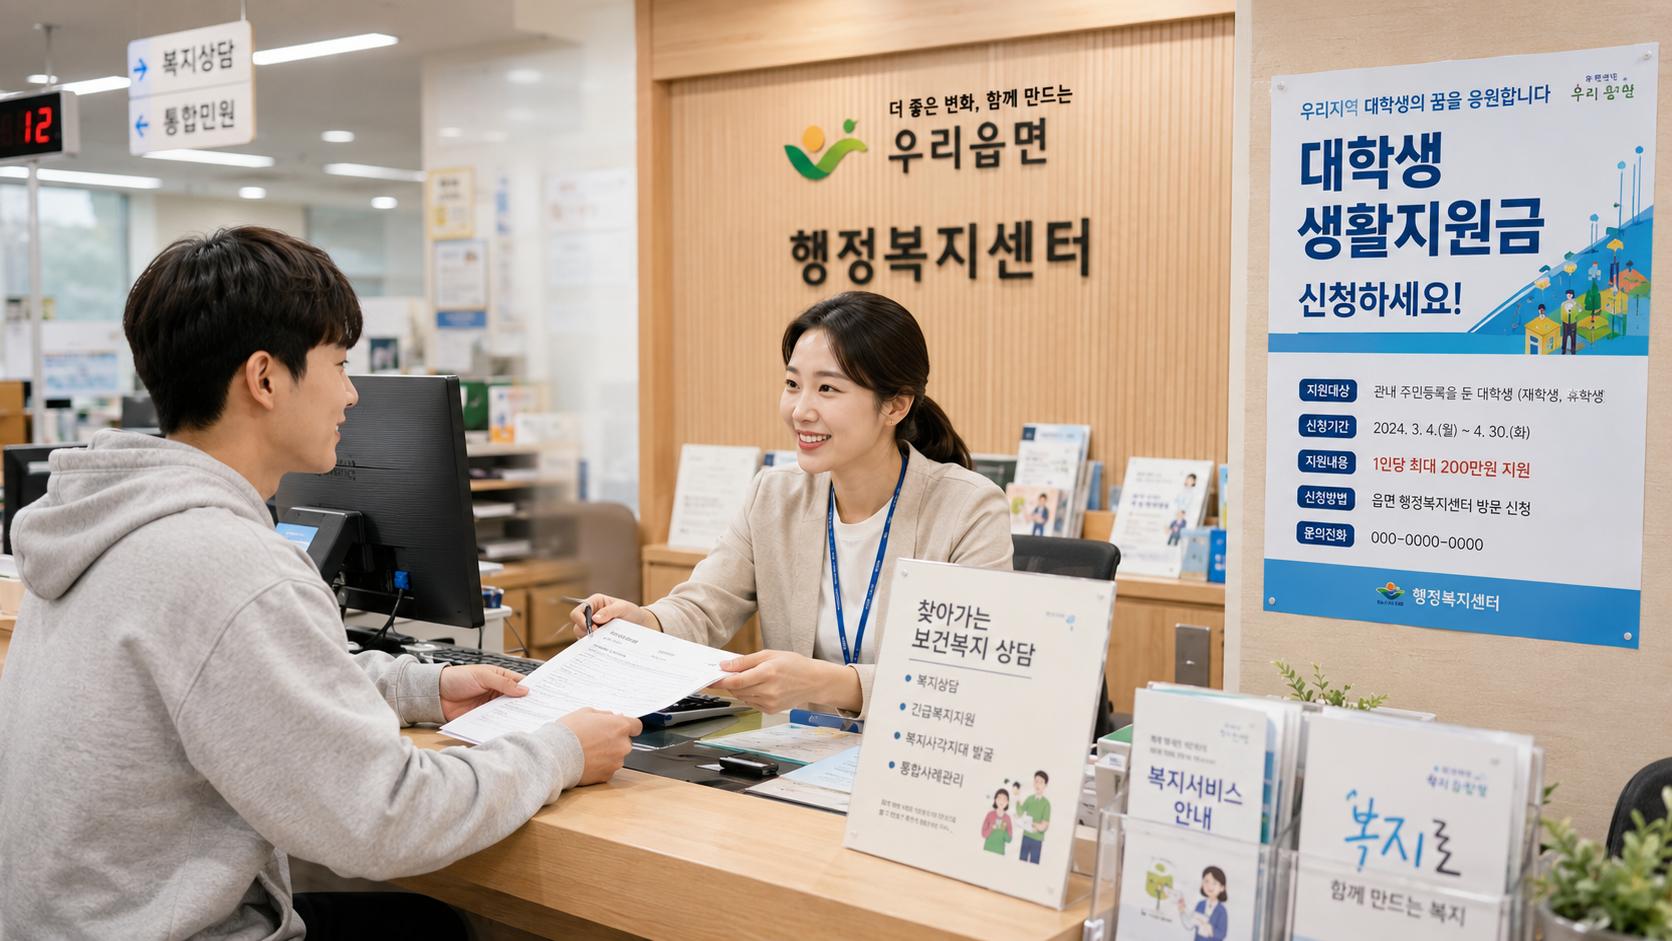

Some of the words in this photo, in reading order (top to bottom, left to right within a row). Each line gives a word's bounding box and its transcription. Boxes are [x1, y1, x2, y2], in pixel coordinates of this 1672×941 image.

[163, 40, 234, 76] 복지상담
[164, 100, 234, 136] 통합민원
[890, 100, 902, 118] 더
[909, 97, 938, 117] 좋은
[945, 94, 979, 114] 변화,
[987, 89, 1017, 110] 함께
[1025, 85, 1072, 106] 만드는
[1301, 99, 1357, 120] 우리지역
[1365, 94, 1424, 115] 대학생의
[1430, 91, 1462, 111] 꿈을
[1468, 85, 1551, 109] 응원합니다
[25, 107, 52, 143] 12
[889, 118, 1046, 173] 우리읍면
[1301, 132, 1441, 192] 대학생
[1297, 198, 1544, 260] 생활지원금
[790, 218, 1090, 287] 행정복지센터
[1299, 281, 1461, 318] 신청하세요!
[1307, 384, 1350, 397] 지원대상
[1374, 386, 1396, 398] 관내
[1400, 386, 1457, 400] 주민등록을
[1461, 387, 1472, 400] 둔
[1478, 387, 1512, 401] 대학생
[1518, 388, 1562, 402] (재학생,
[1307, 420, 1349, 433] 신청기간
[1374, 422, 1407, 434] 2024.
[1412, 423, 1422, 435] 3.
[1426, 424, 1457, 437] 4.(월)
[1474, 425, 1484, 437] 4.
[1489, 426, 1530, 440] 30.(화)
[1306, 455, 1348, 469] 지원내용
[1374, 457, 1405, 472] 1인당
[1410, 458, 1435, 474] 최대
[1441, 460, 1496, 477] 200만원
[1502, 462, 1529, 478] 지원
[1305, 491, 1347, 506] 신청방법
[1372, 494, 1395, 508] 읍면
[1399, 495, 1471, 512] 행정복지센터
[1477, 500, 1501, 514] 방문
[1506, 501, 1530, 516] 신청
[1371, 531, 1483, 551] 000-0000-0000
[917, 599, 991, 631] 찾아가는
[1413, 588, 1499, 611] 행정복지센터
[912, 629, 987, 660] 보건복지
[996, 640, 1035, 667] 상담
[917, 674, 959, 693] 복지상담
[912, 703, 975, 727] 긴급복지지원
[906, 732, 969, 756] 복지사각지대
[973, 746, 993, 762] 발굴
[900, 761, 963, 788] 통합사례관리
[1148, 766, 1242, 808] 복지서비스
[1175, 801, 1211, 830] 안내
[1331, 880, 1365, 905] 함께
[1371, 889, 1423, 919] 만드는
